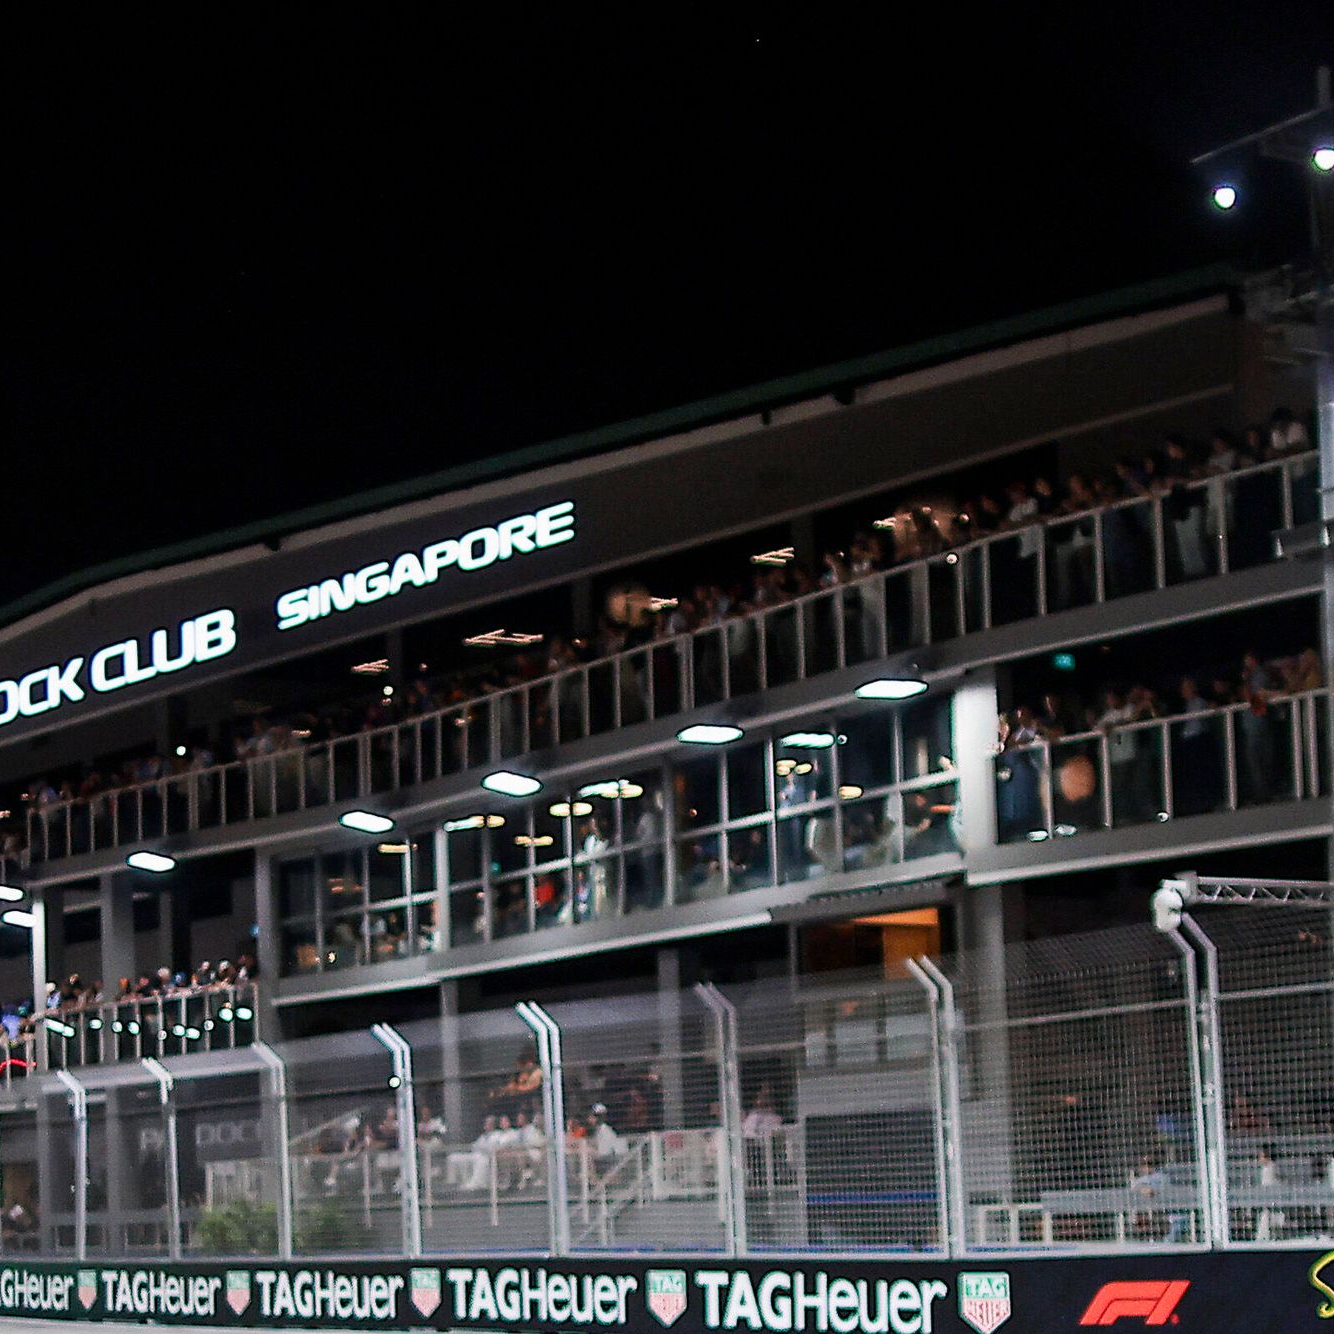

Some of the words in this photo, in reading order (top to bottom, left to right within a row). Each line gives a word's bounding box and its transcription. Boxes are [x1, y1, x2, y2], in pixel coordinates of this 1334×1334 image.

[277, 501, 575, 631] SINGAPORE
[90, 608, 237, 693] CLUB
[964, 1277, 1008, 1298] TAG
